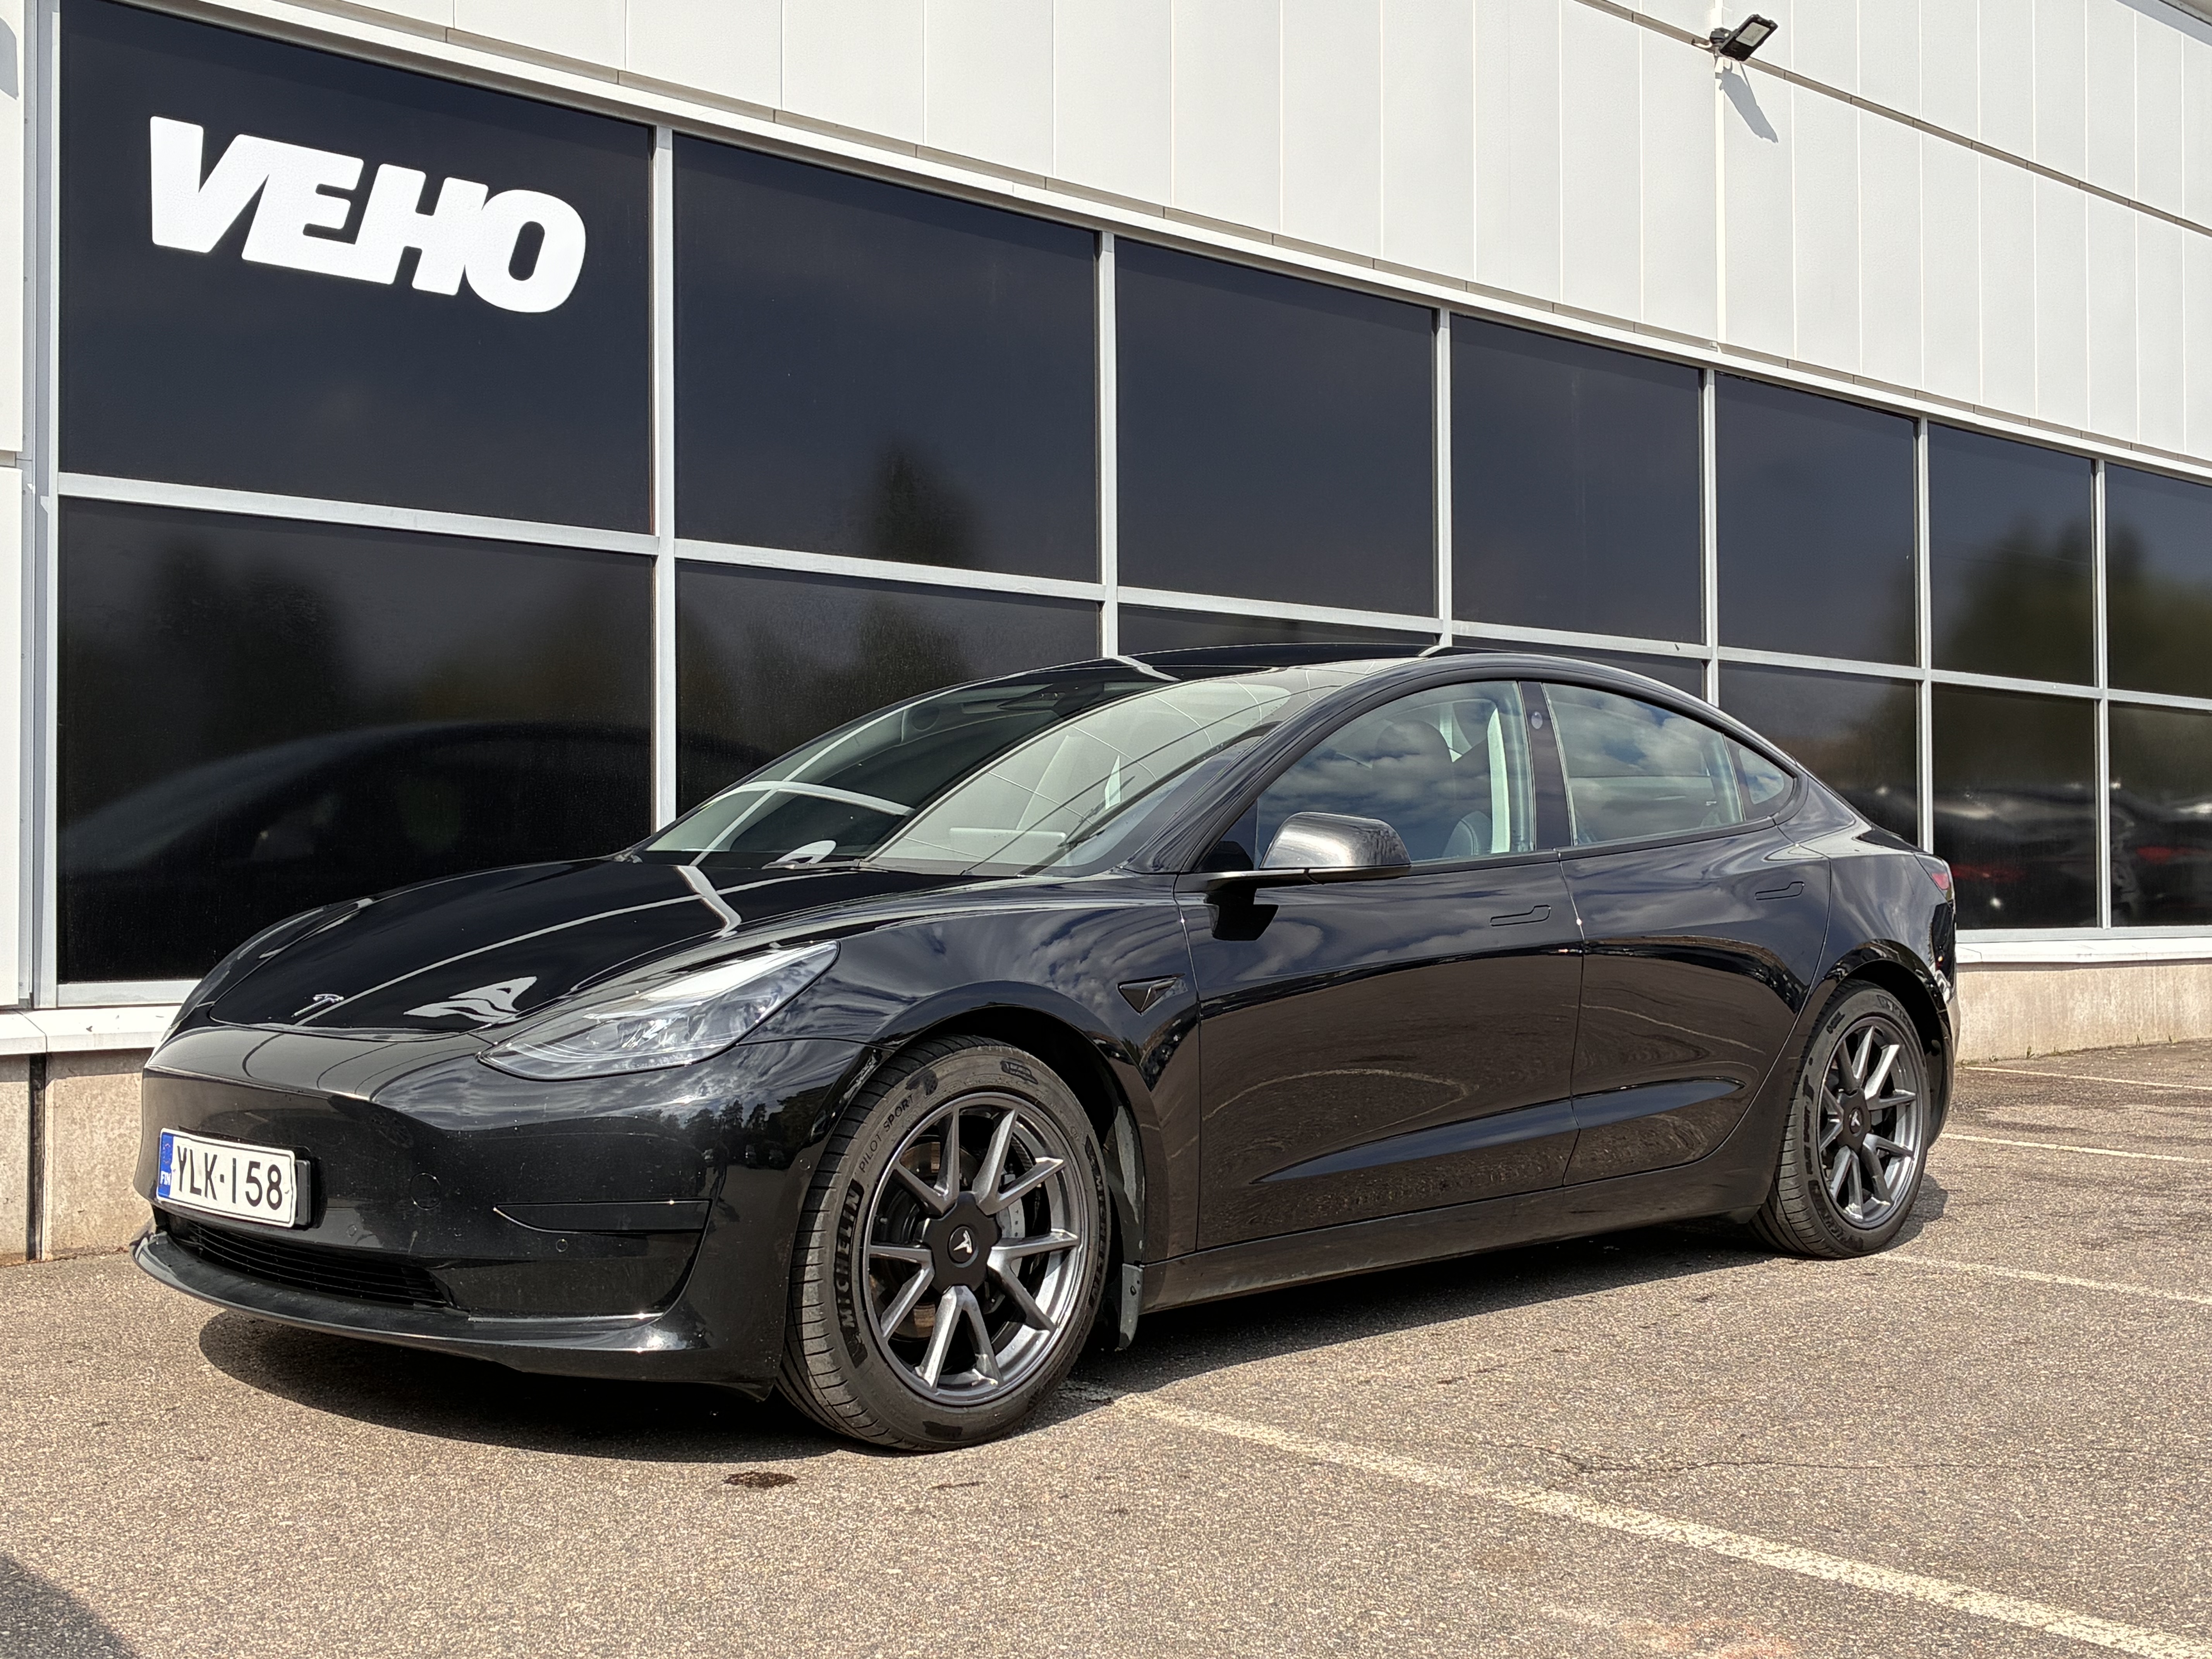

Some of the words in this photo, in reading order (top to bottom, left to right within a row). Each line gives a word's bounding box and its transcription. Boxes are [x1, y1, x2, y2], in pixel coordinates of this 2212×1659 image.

[150, 116, 586, 313] VEHO
[177, 1145, 283, 1211] YLK-158
[859, 1134, 882, 1173] PILOT
[883, 1094, 914, 1132] SPORT
[836, 1187, 859, 1328] MICHELIN
